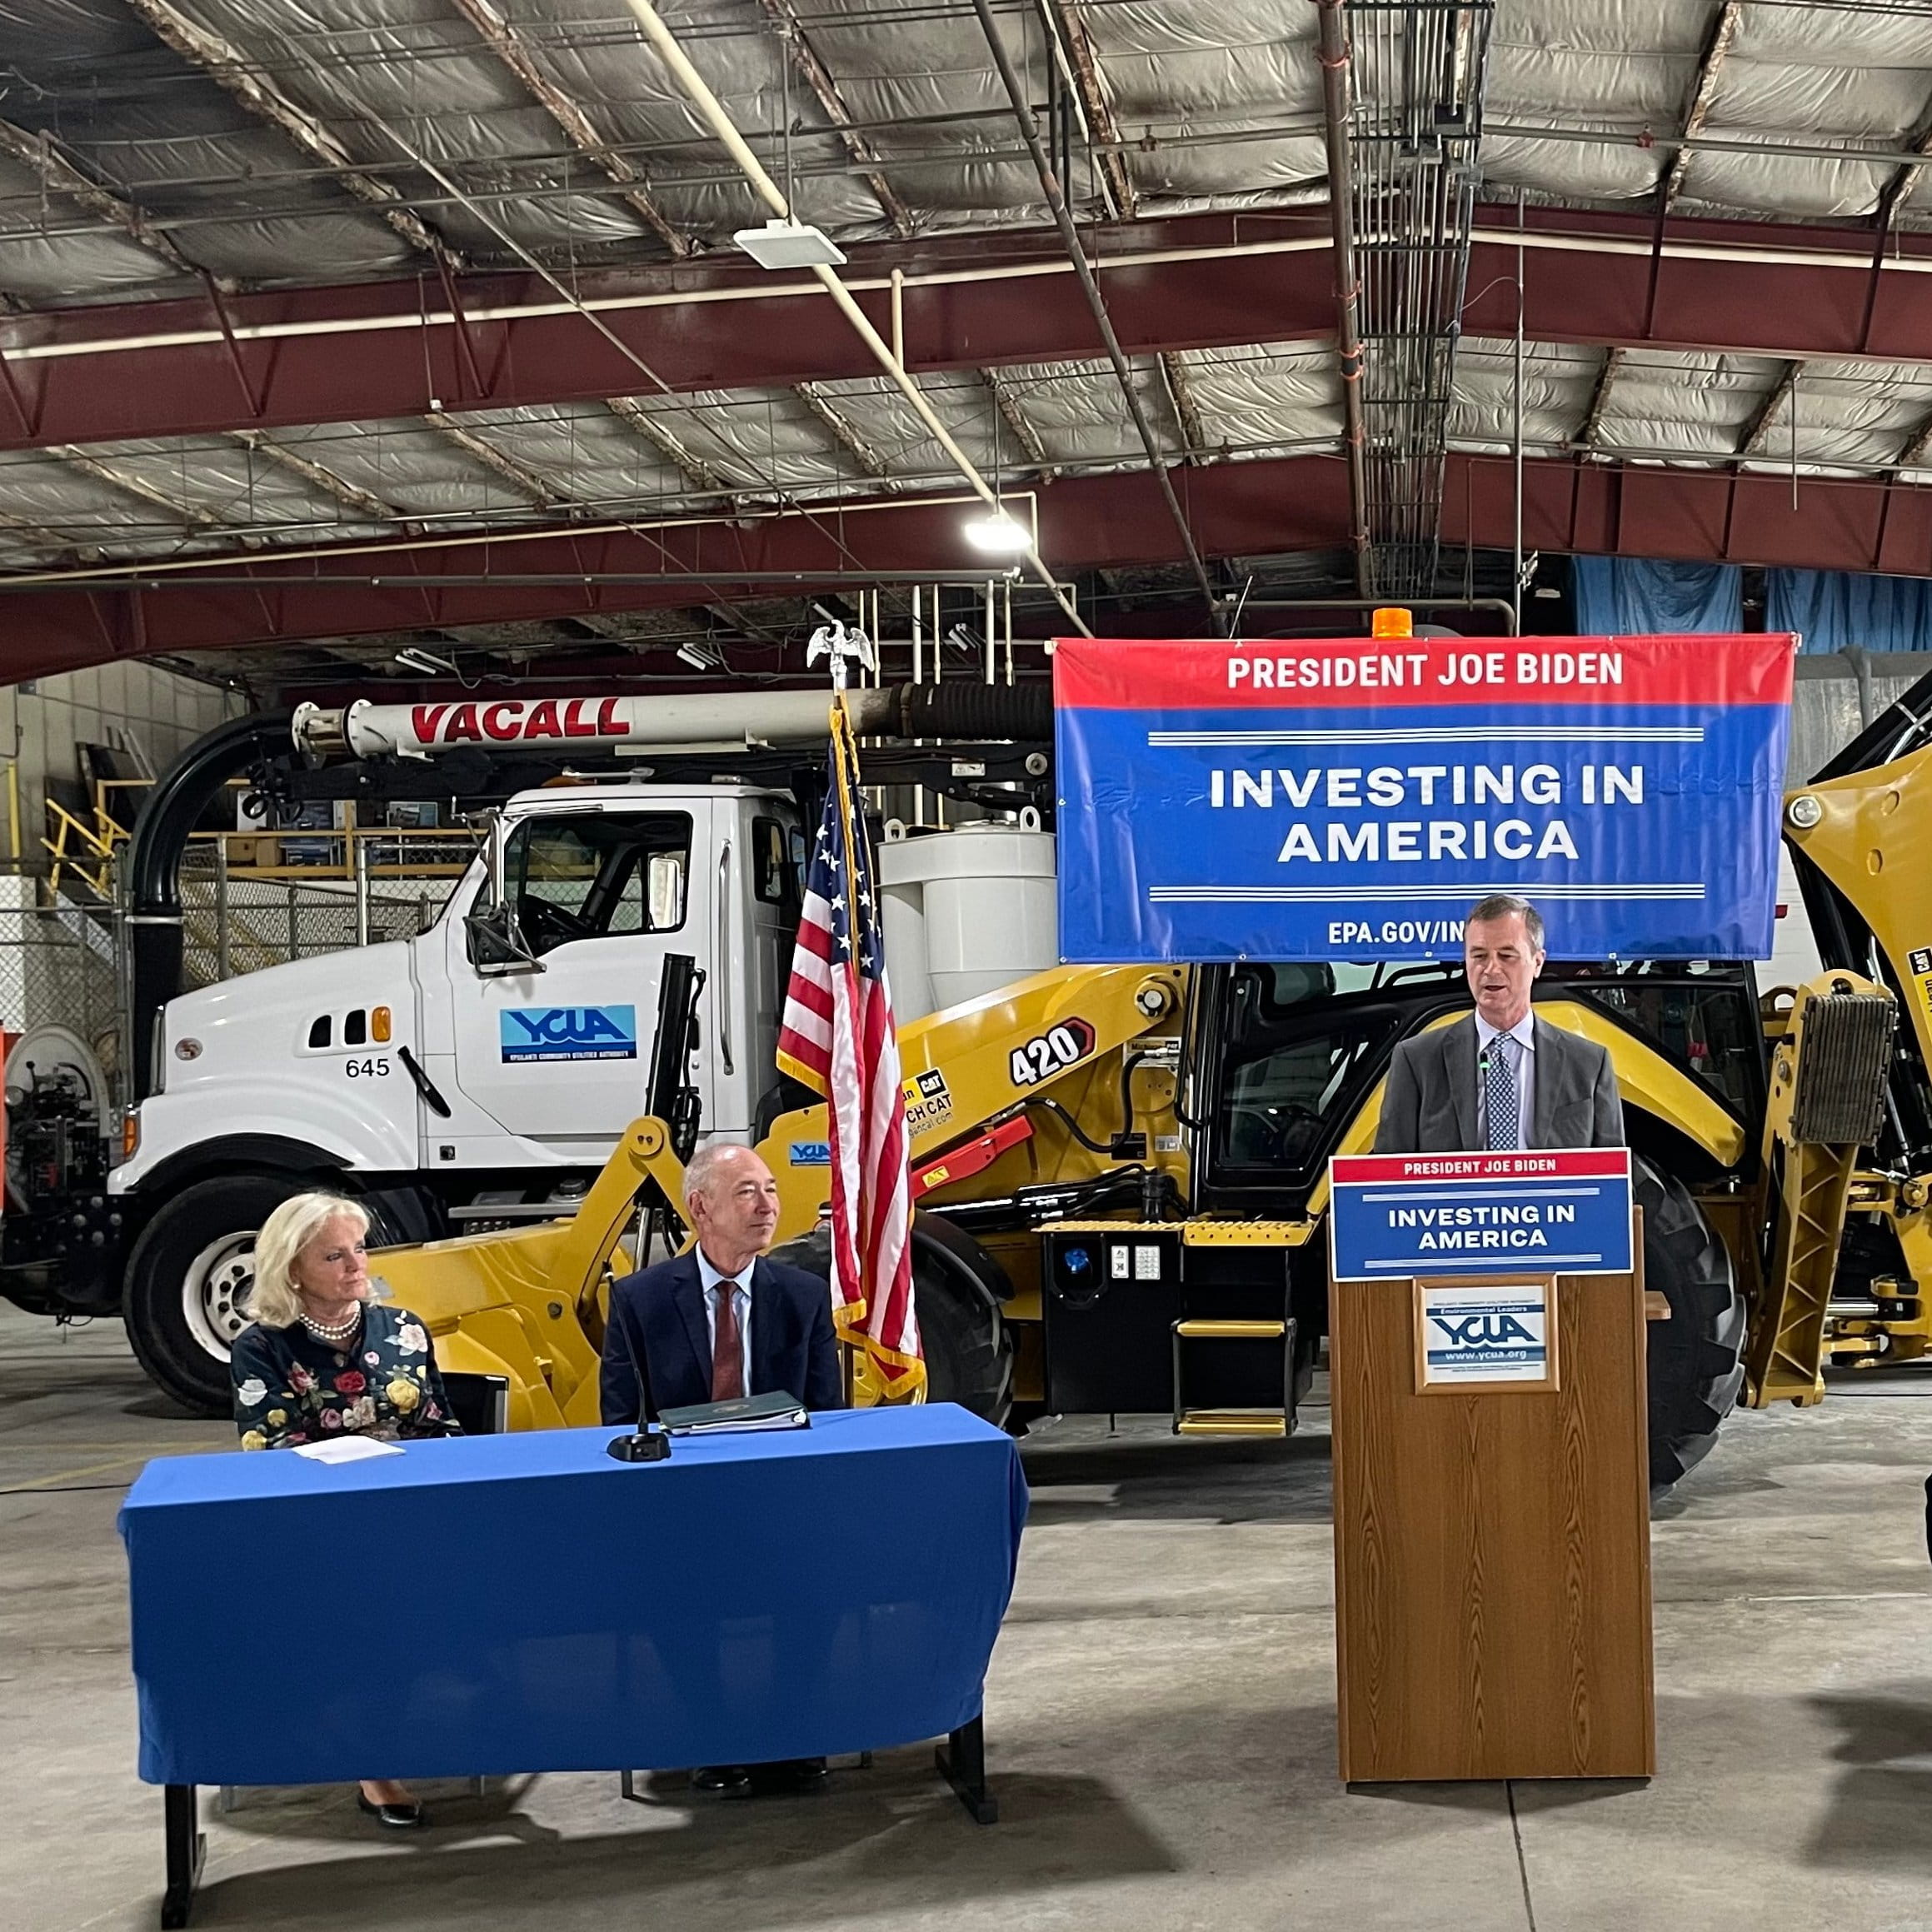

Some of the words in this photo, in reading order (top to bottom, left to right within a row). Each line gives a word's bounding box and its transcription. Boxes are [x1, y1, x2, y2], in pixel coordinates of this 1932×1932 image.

[1227, 654, 1429, 689] PRESIDENT
[1438, 652, 1506, 686] JOE
[1516, 652, 1623, 685] BIDEN
[412, 697, 631, 744] VACALL
[1210, 764, 1562, 808] INVESTING
[1581, 765, 1645, 806] IN
[1276, 818, 1580, 863] AMERICA
[1328, 920, 1465, 944] EPA.GOV/IN
[1914, 952, 1930, 972] CAT
[506, 1008, 630, 1043] YCUA
[346, 1058, 390, 1078] 645
[1011, 1026, 1080, 1085] 420
[920, 1075, 941, 1093] CAT
[906, 1106, 926, 1124] CH
[926, 1093, 952, 1115] CAT
[1403, 1161, 1480, 1176] PRESIDENT
[1484, 1160, 1511, 1173] JOE
[1514, 1158, 1557, 1172] BIDEN
[1388, 1206, 1540, 1228] INVESTING
[1547, 1204, 1575, 1223] IN
[1418, 1228, 1549, 1251] AMERICA
[1430, 1315, 1540, 1345] YCUA
[1445, 1350, 1527, 1362] www.ycua.org
